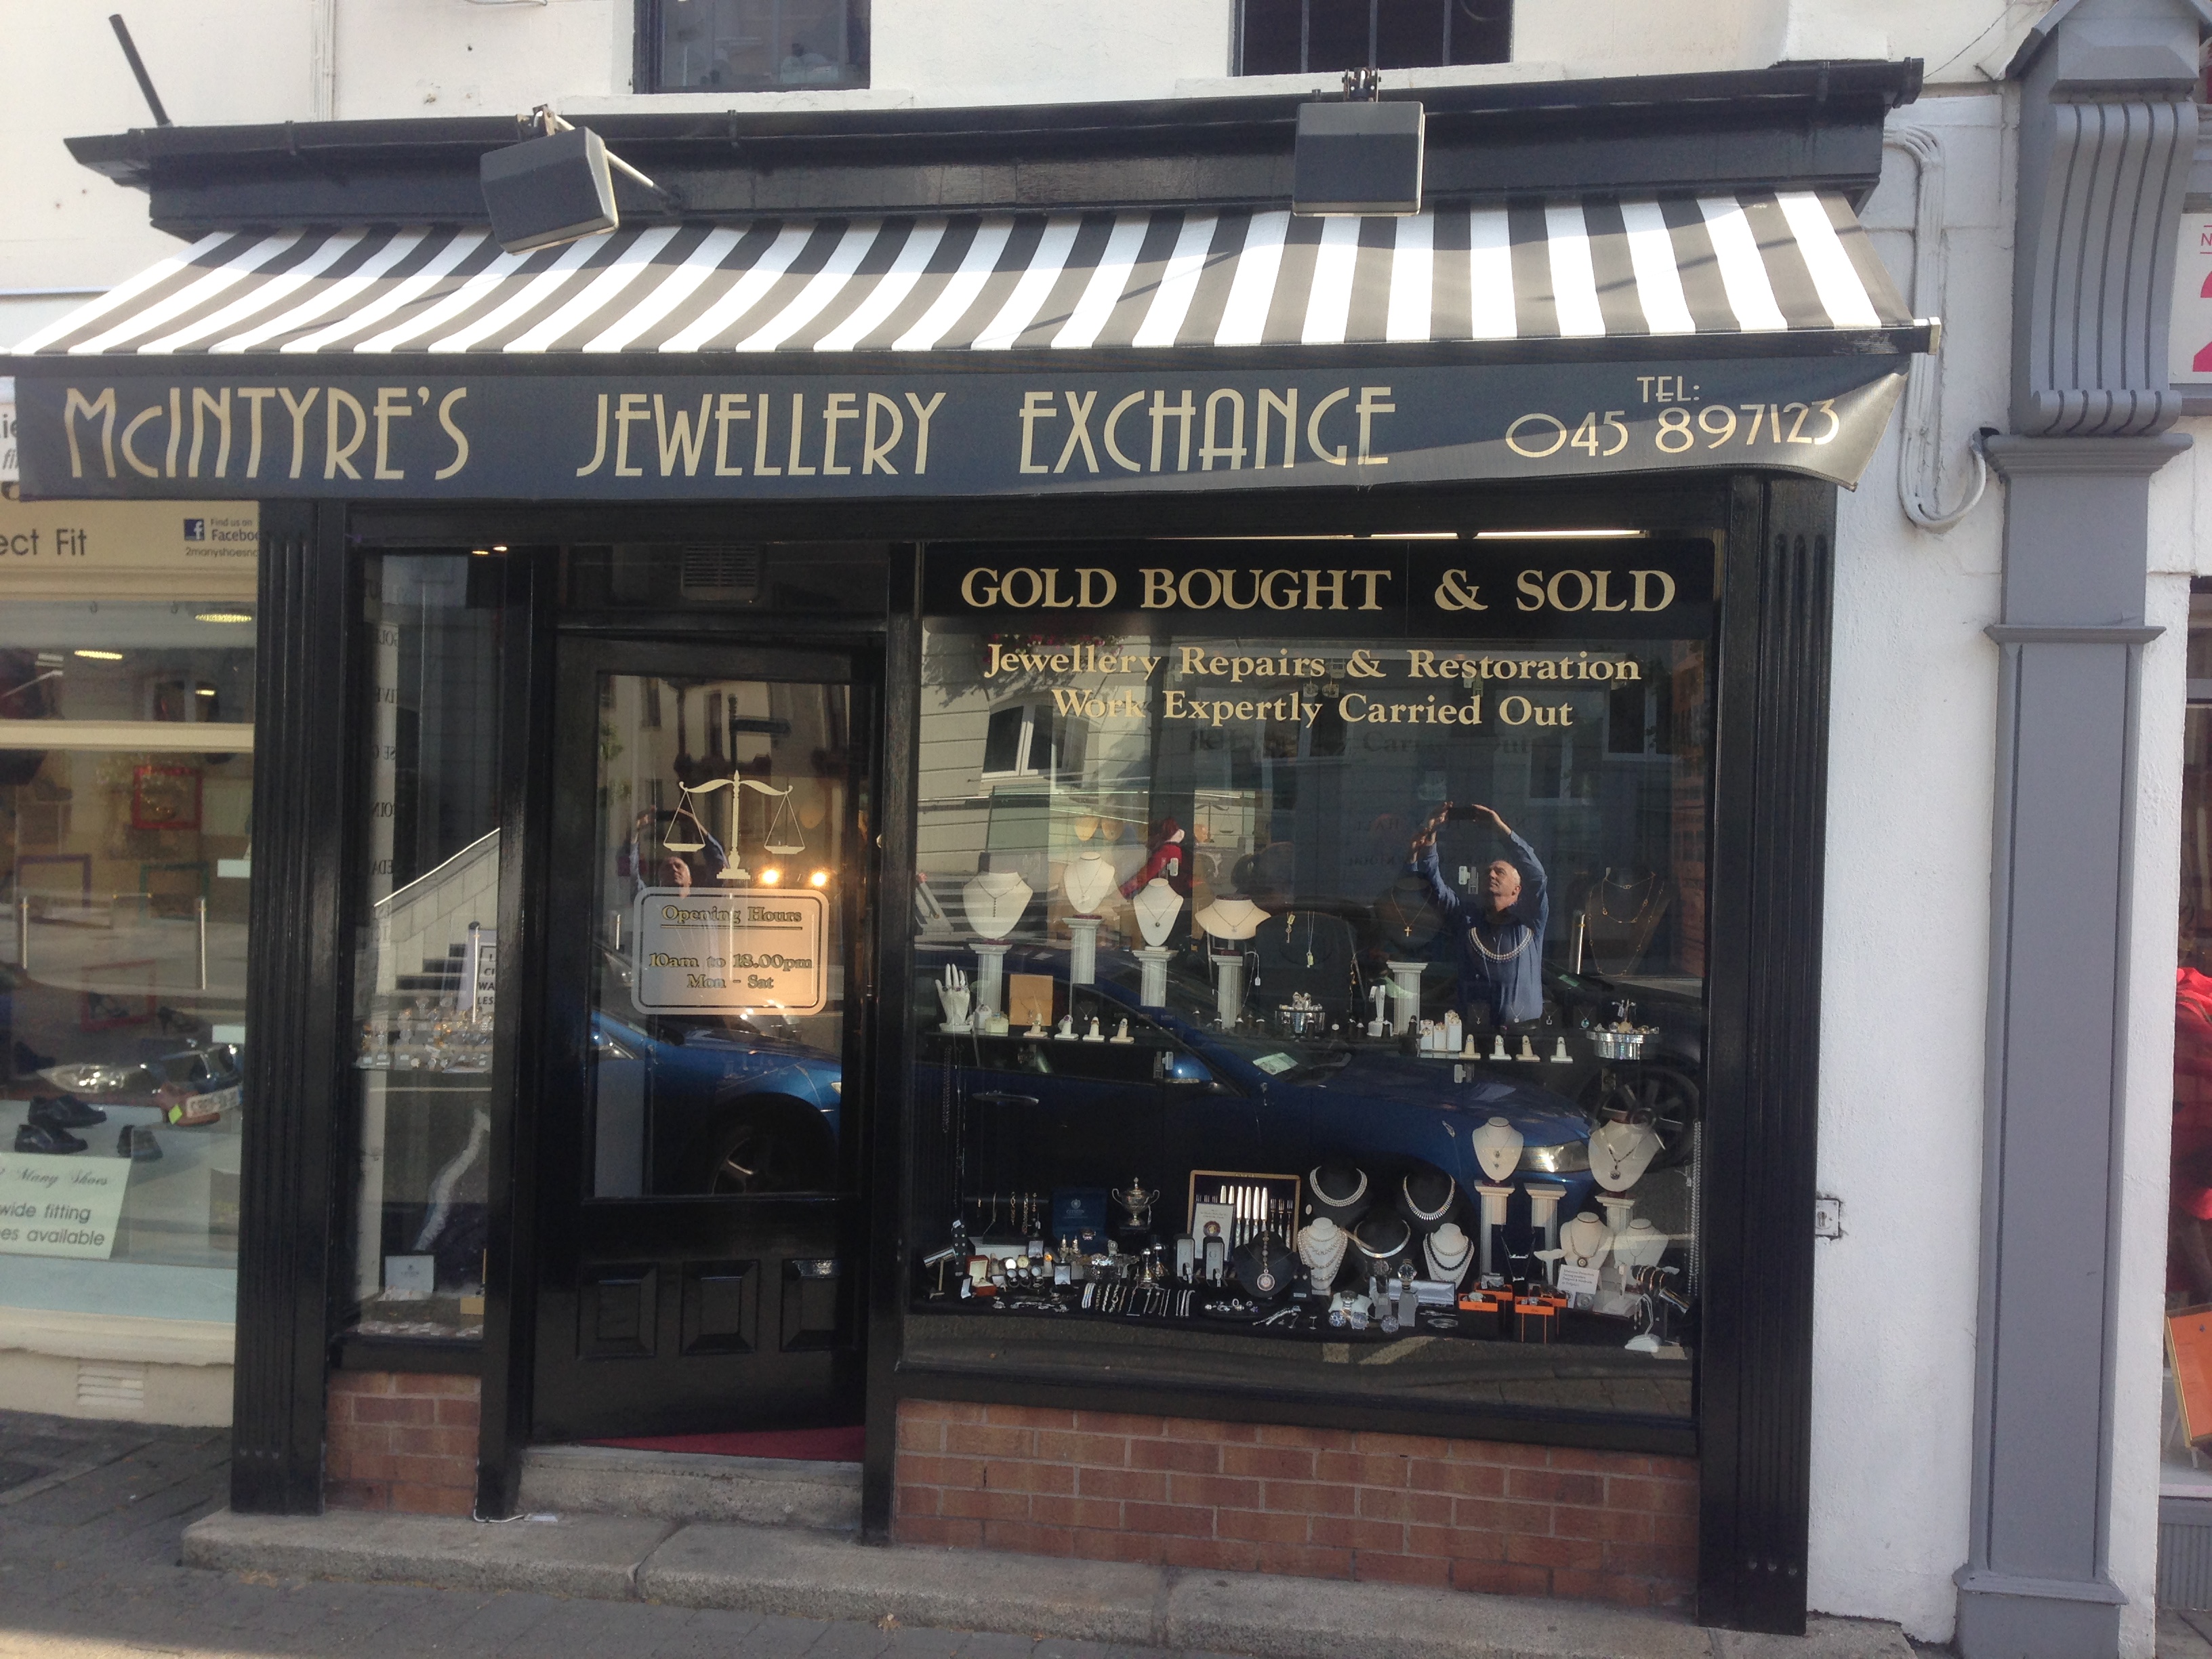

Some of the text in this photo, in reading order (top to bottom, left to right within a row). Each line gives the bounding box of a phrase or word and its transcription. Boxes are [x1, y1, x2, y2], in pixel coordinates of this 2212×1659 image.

[1637, 376, 1700, 403] TEL:
[577, 392, 946, 477] JEWELLERY
[1019, 387, 1395, 474] EXCHANGE
[1506, 398, 1839, 457] 045 897123
[211, 518, 228, 527] Find
[56, 528, 87, 556] Fit
[961, 567, 1675, 611] GOLD BOUGHT & SOLD
[984, 644, 1641, 682] Jewellery Repairs & Restoration
[1050, 689, 1573, 728] Work Expertly Carried Out
[661, 905, 802, 924] Opening Hours
[649, 952, 812, 972] 10am to 18.00pm
[687, 974, 726, 989] Mon
[747, 975, 774, 989] Sat
[44, 1204, 91, 1224] fitting
[27, 1229, 104, 1246] available
